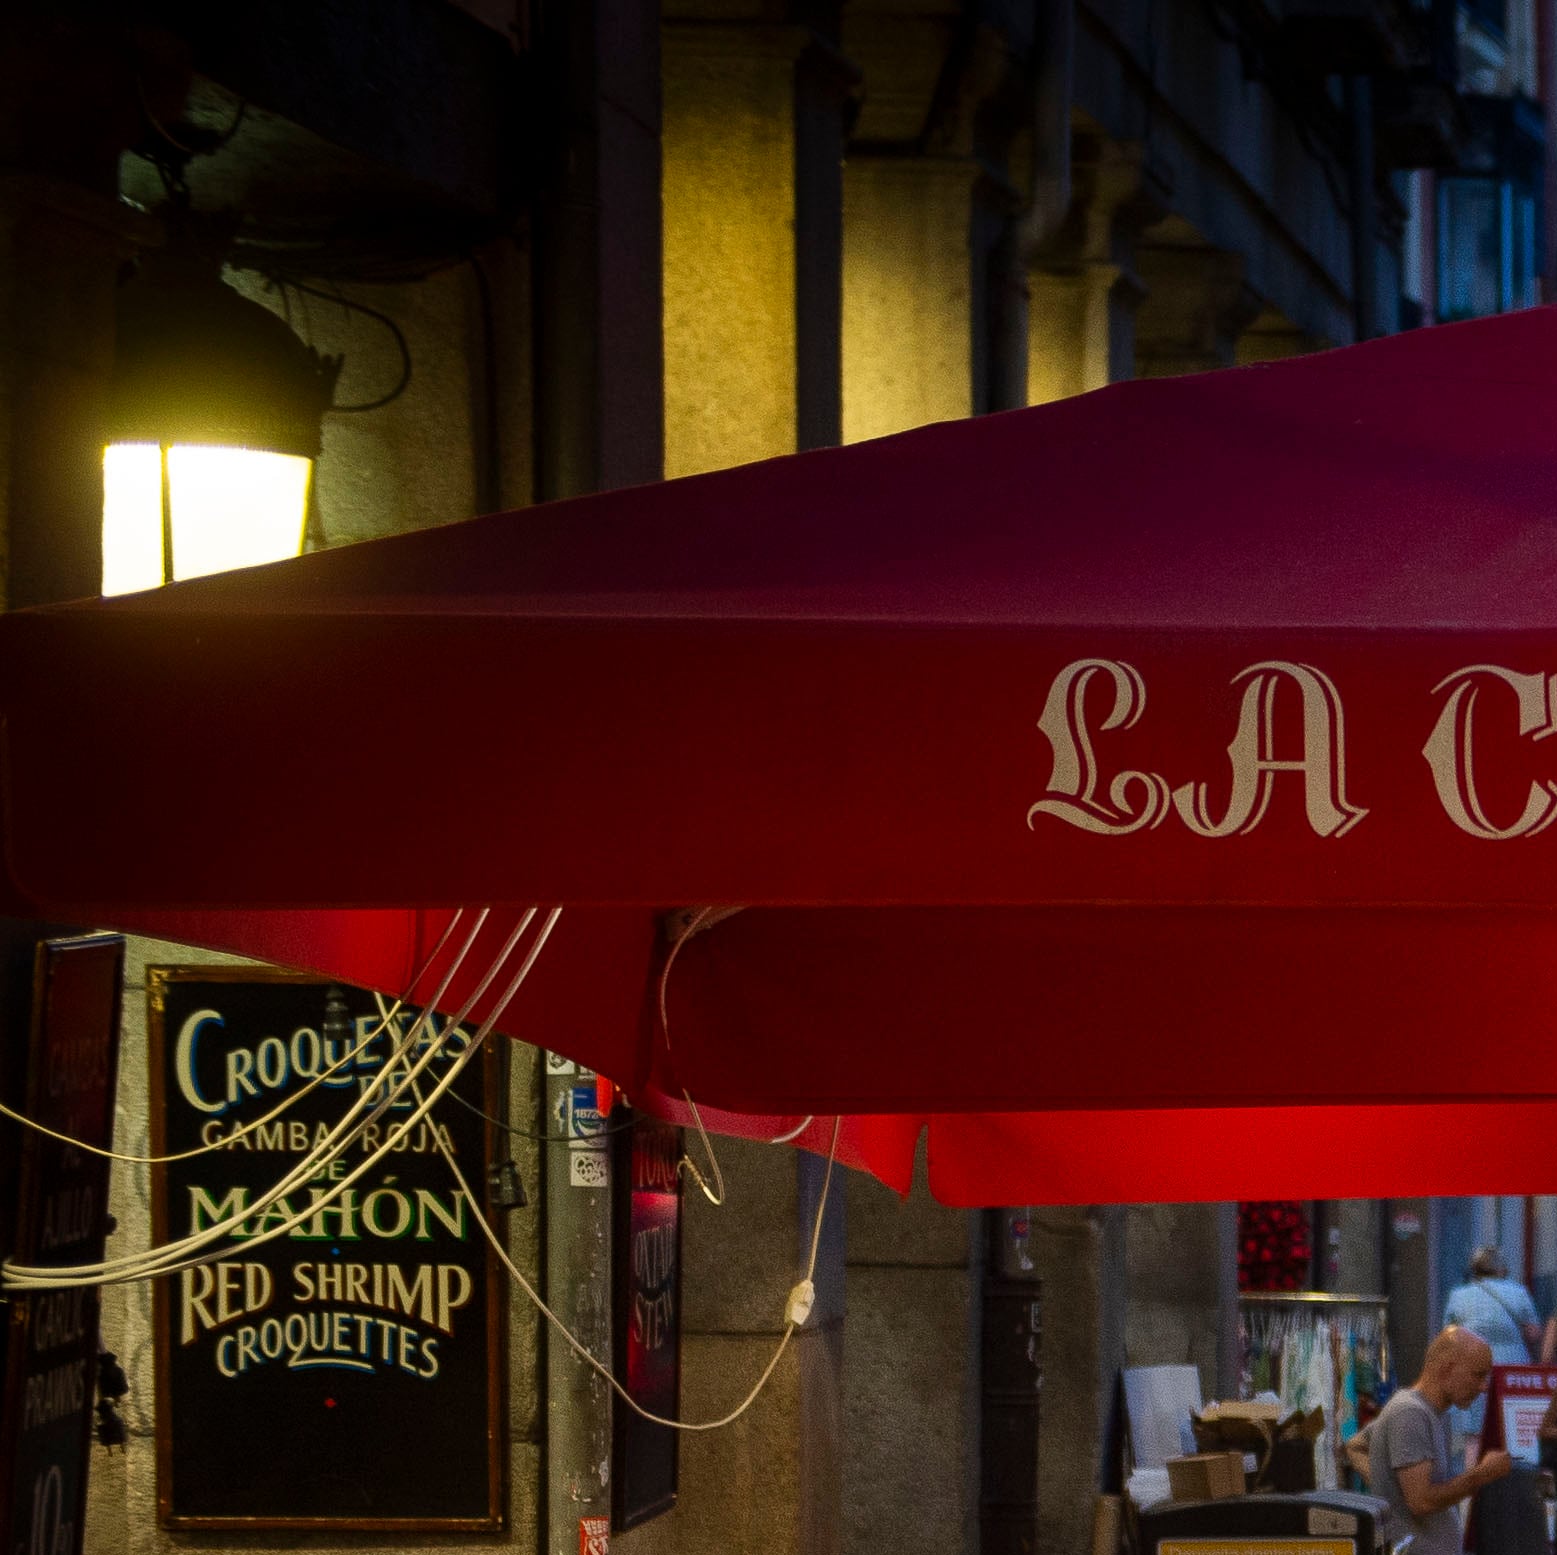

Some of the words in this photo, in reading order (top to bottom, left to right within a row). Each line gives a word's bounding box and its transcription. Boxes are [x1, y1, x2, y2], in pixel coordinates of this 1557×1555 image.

[1027, 657, 1370, 841] LA
[201, 1119, 339, 1152] GAMBA
[362, 1123, 457, 1153] ROJA
[187, 1176, 470, 1242] MAHÓN
[180, 1262, 273, 1346] RED
[293, 1262, 473, 1337] SHRIMP
[216, 1312, 440, 1380] CROQUETTES
